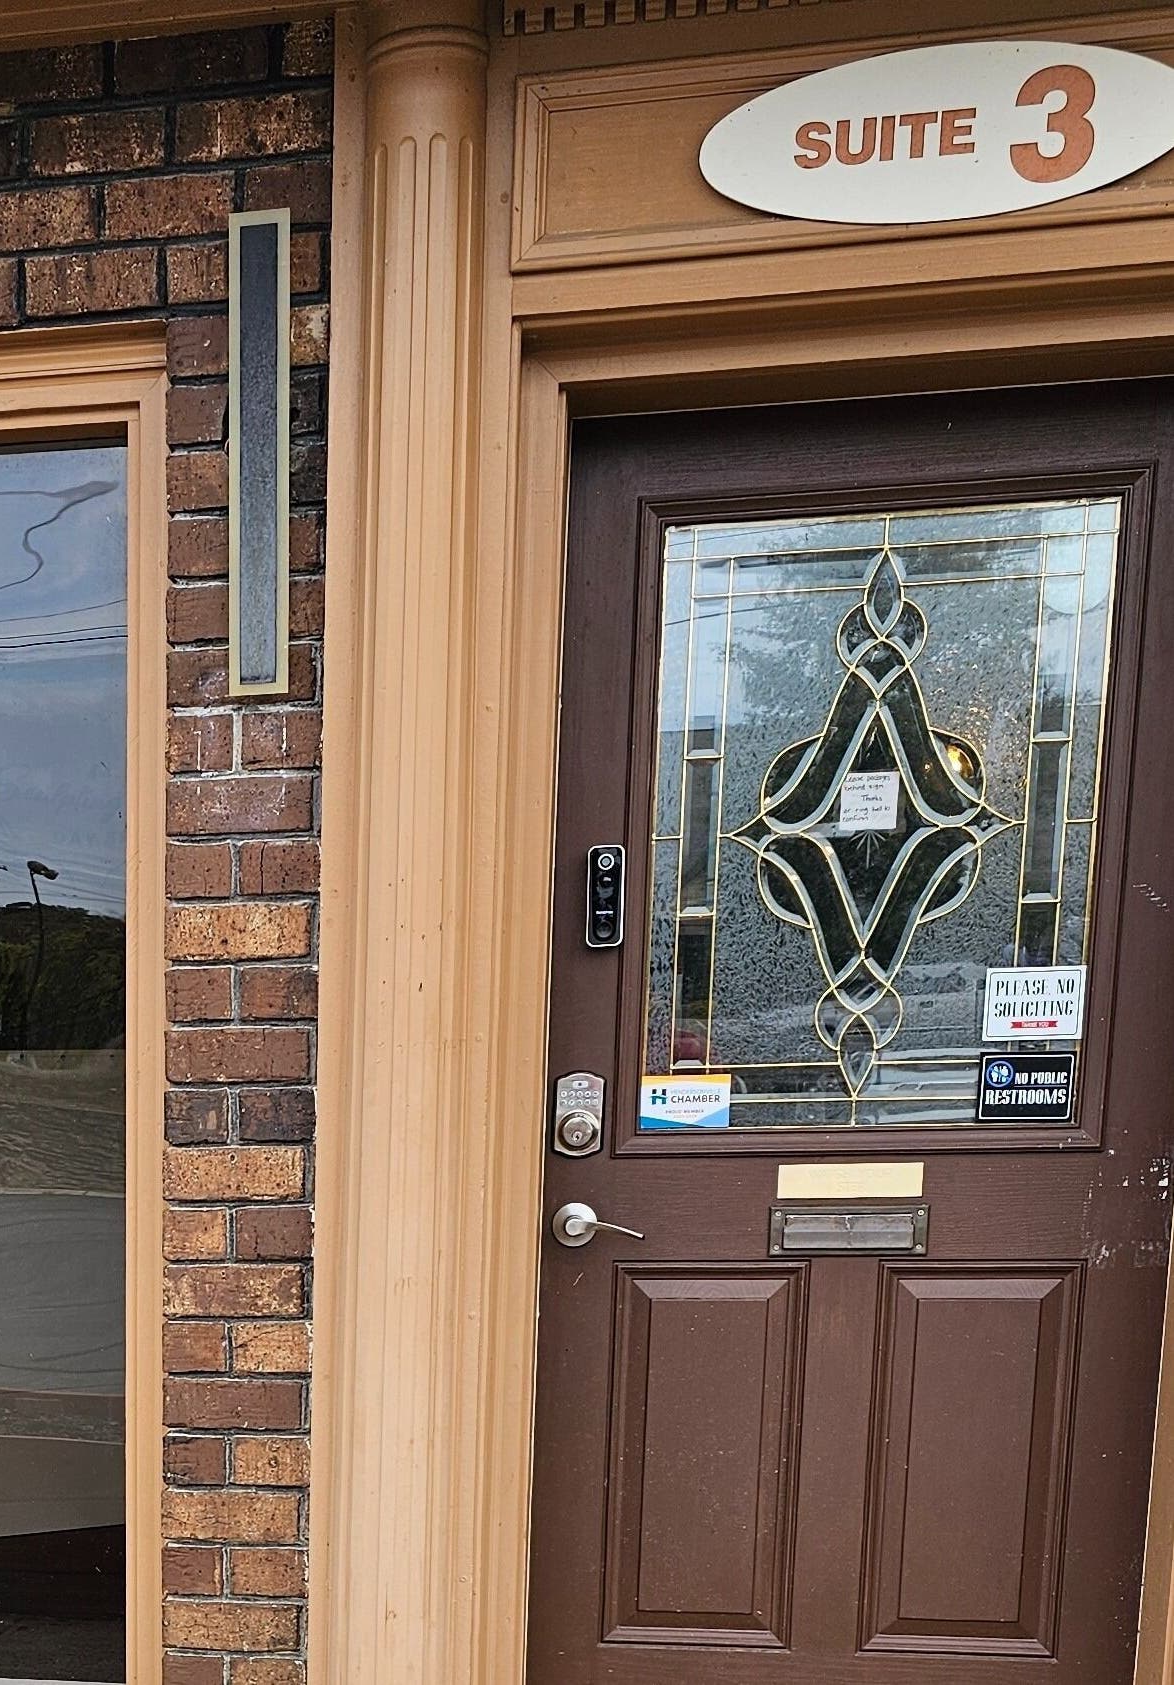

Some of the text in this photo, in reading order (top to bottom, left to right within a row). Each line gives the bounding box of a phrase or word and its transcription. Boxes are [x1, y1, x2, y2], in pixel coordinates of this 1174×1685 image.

[794, 64, 1096, 184] SUITE 3
[996, 979, 1075, 996] PLEASE NO
[995, 1000, 1073, 1018] SOLICITING
[1015, 1072, 1067, 1084] NO PUBLIC
[671, 1095, 720, 1103] CHAMBER
[985, 1089, 1066, 1104] RESTROOMS
